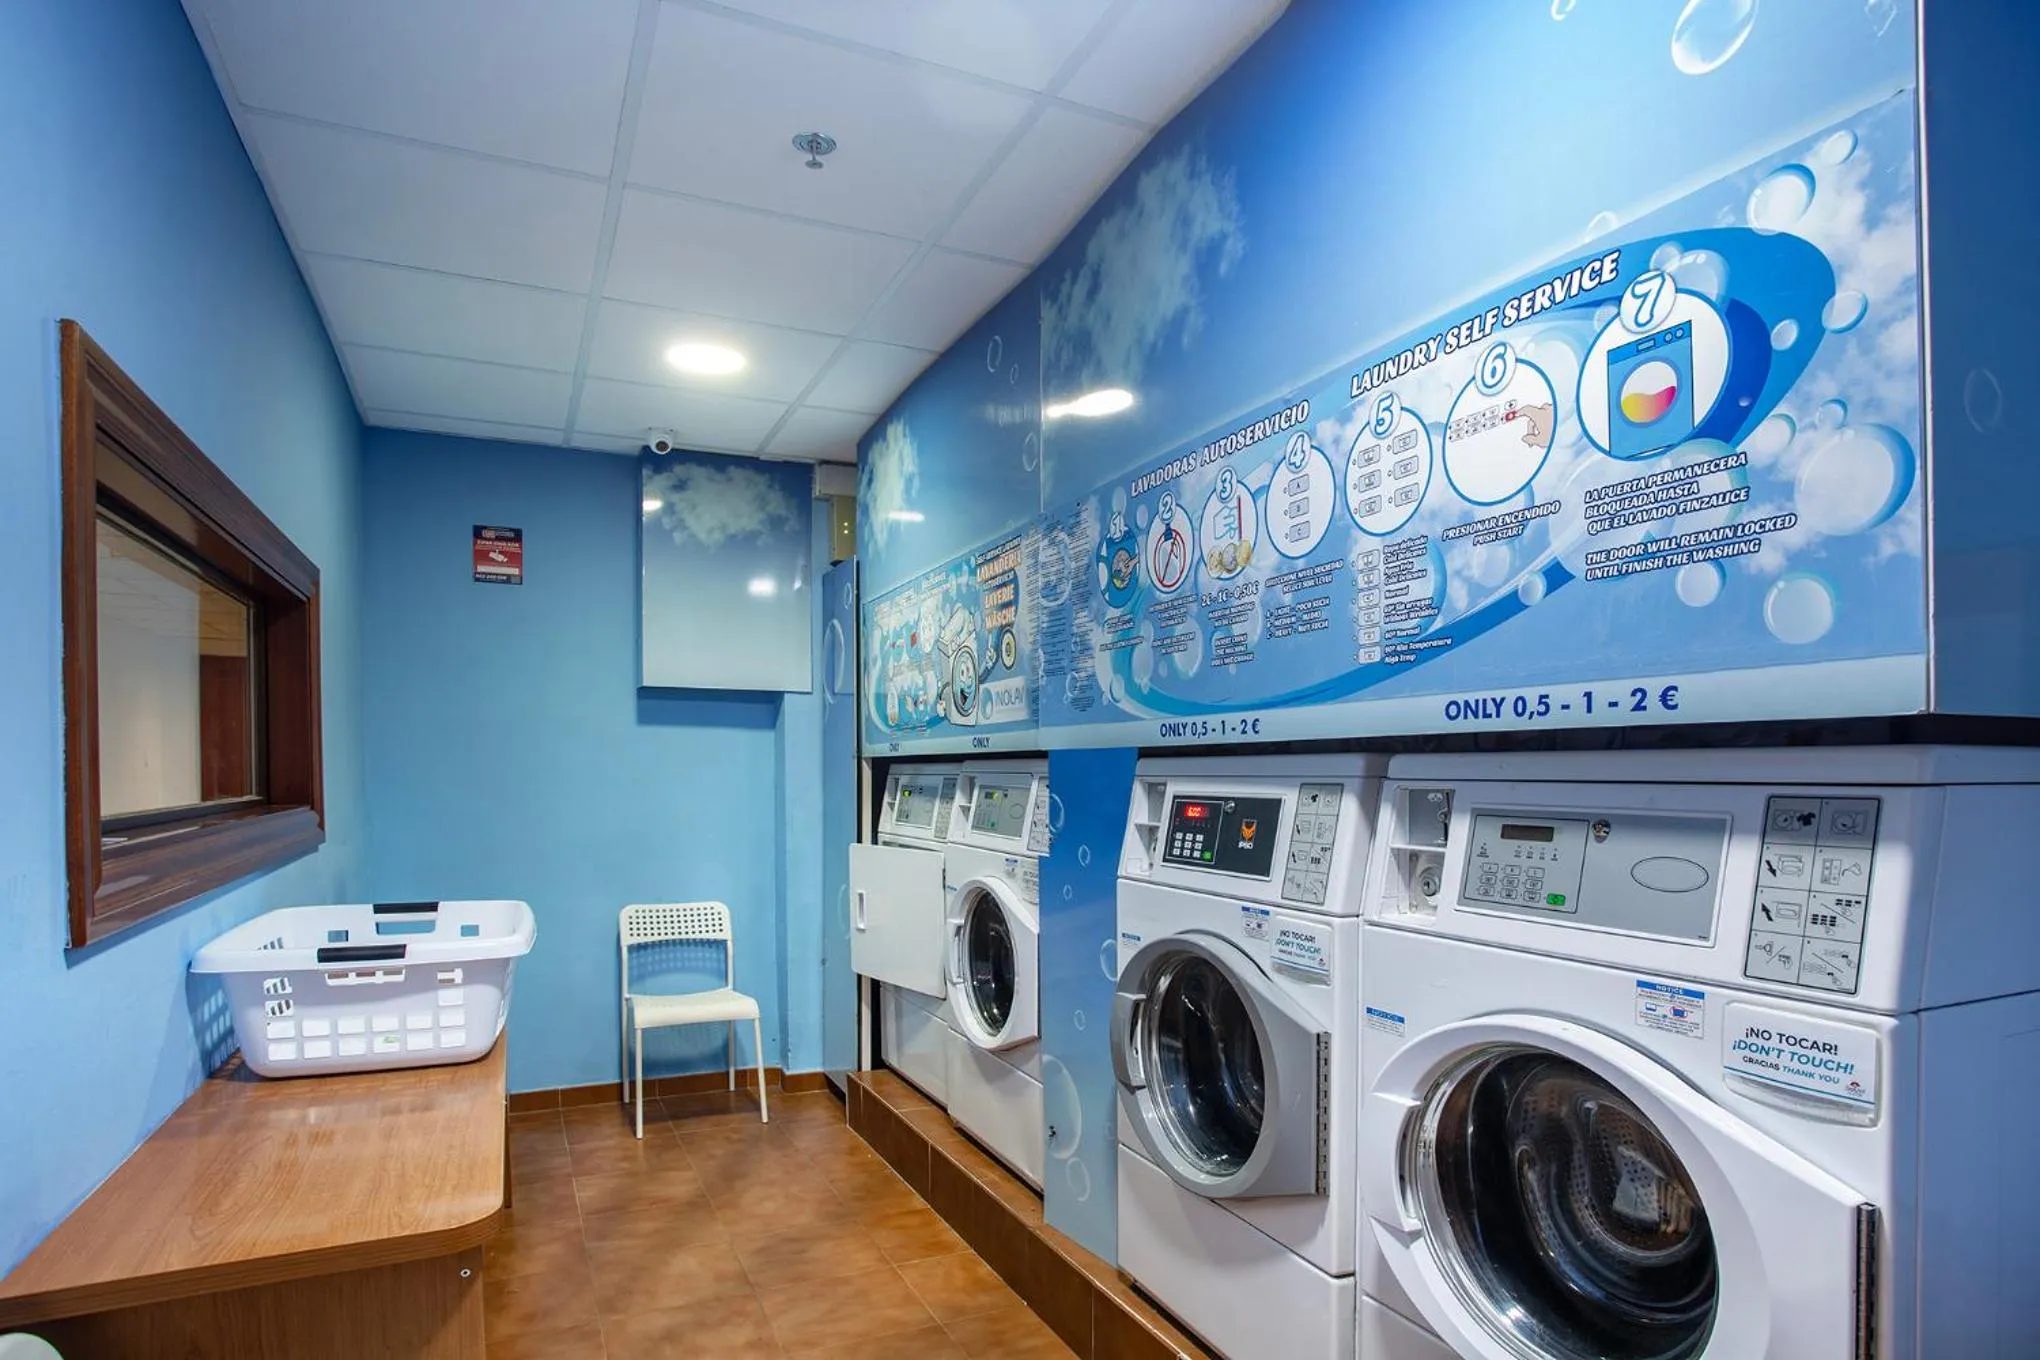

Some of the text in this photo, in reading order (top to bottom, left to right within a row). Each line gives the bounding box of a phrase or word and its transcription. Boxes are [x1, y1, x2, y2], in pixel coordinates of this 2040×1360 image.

[1632, 273, 1666, 328] 7
[1350, 249, 1621, 398] LAUNDRY SELF SERVICE
[1480, 342, 1507, 389] 6
[1374, 393, 1395, 436] 5
[1131, 399, 1311, 498] LAVADORAS AUTOSERVICIO
[1288, 433, 1307, 469] 4
[1220, 468, 1233, 500] 3
[1585, 452, 1747, 503] LA PUERTA PERMANECERA
[1162, 493, 1174, 520] 2
[1585, 481, 1699, 519] BLOQUEADA HASTA
[1587, 487, 1750, 535] QUE EL LAVADO FINZALICE
[1110, 513, 1123, 541] 1
[1442, 500, 1561, 541] PRESIONAR ENCENDIDO
[1473, 524, 1525, 546] PUSH START
[1586, 513, 1798, 566] THE DOOR WILL REMAIN LOCKED
[1586, 539, 1761, 582] UNTIL FINISH THE WASHING
[1444, 696, 1506, 721] ONLY
[1512, 694, 1550, 720] 0,5
[1582, 691, 1593, 714] 1
[1630, 687, 1648, 712] 2
[1658, 685, 1679, 711] €
[972, 737, 991, 748] ONLY
[1160, 722, 1188, 738] ONLY
[1190, 721, 1208, 739] 0,5
[1220, 720, 1226, 736] 1
[1240, 718, 1248, 734] 2
[1252, 718, 1260, 734] €
[1732, 1040, 1855, 1075] ¡DON'T TOUCH!
[1745, 1027, 1838, 1056] ¡NO TOCAR!
[1742, 1055, 1841, 1085] GRACIAS THANK YOU
